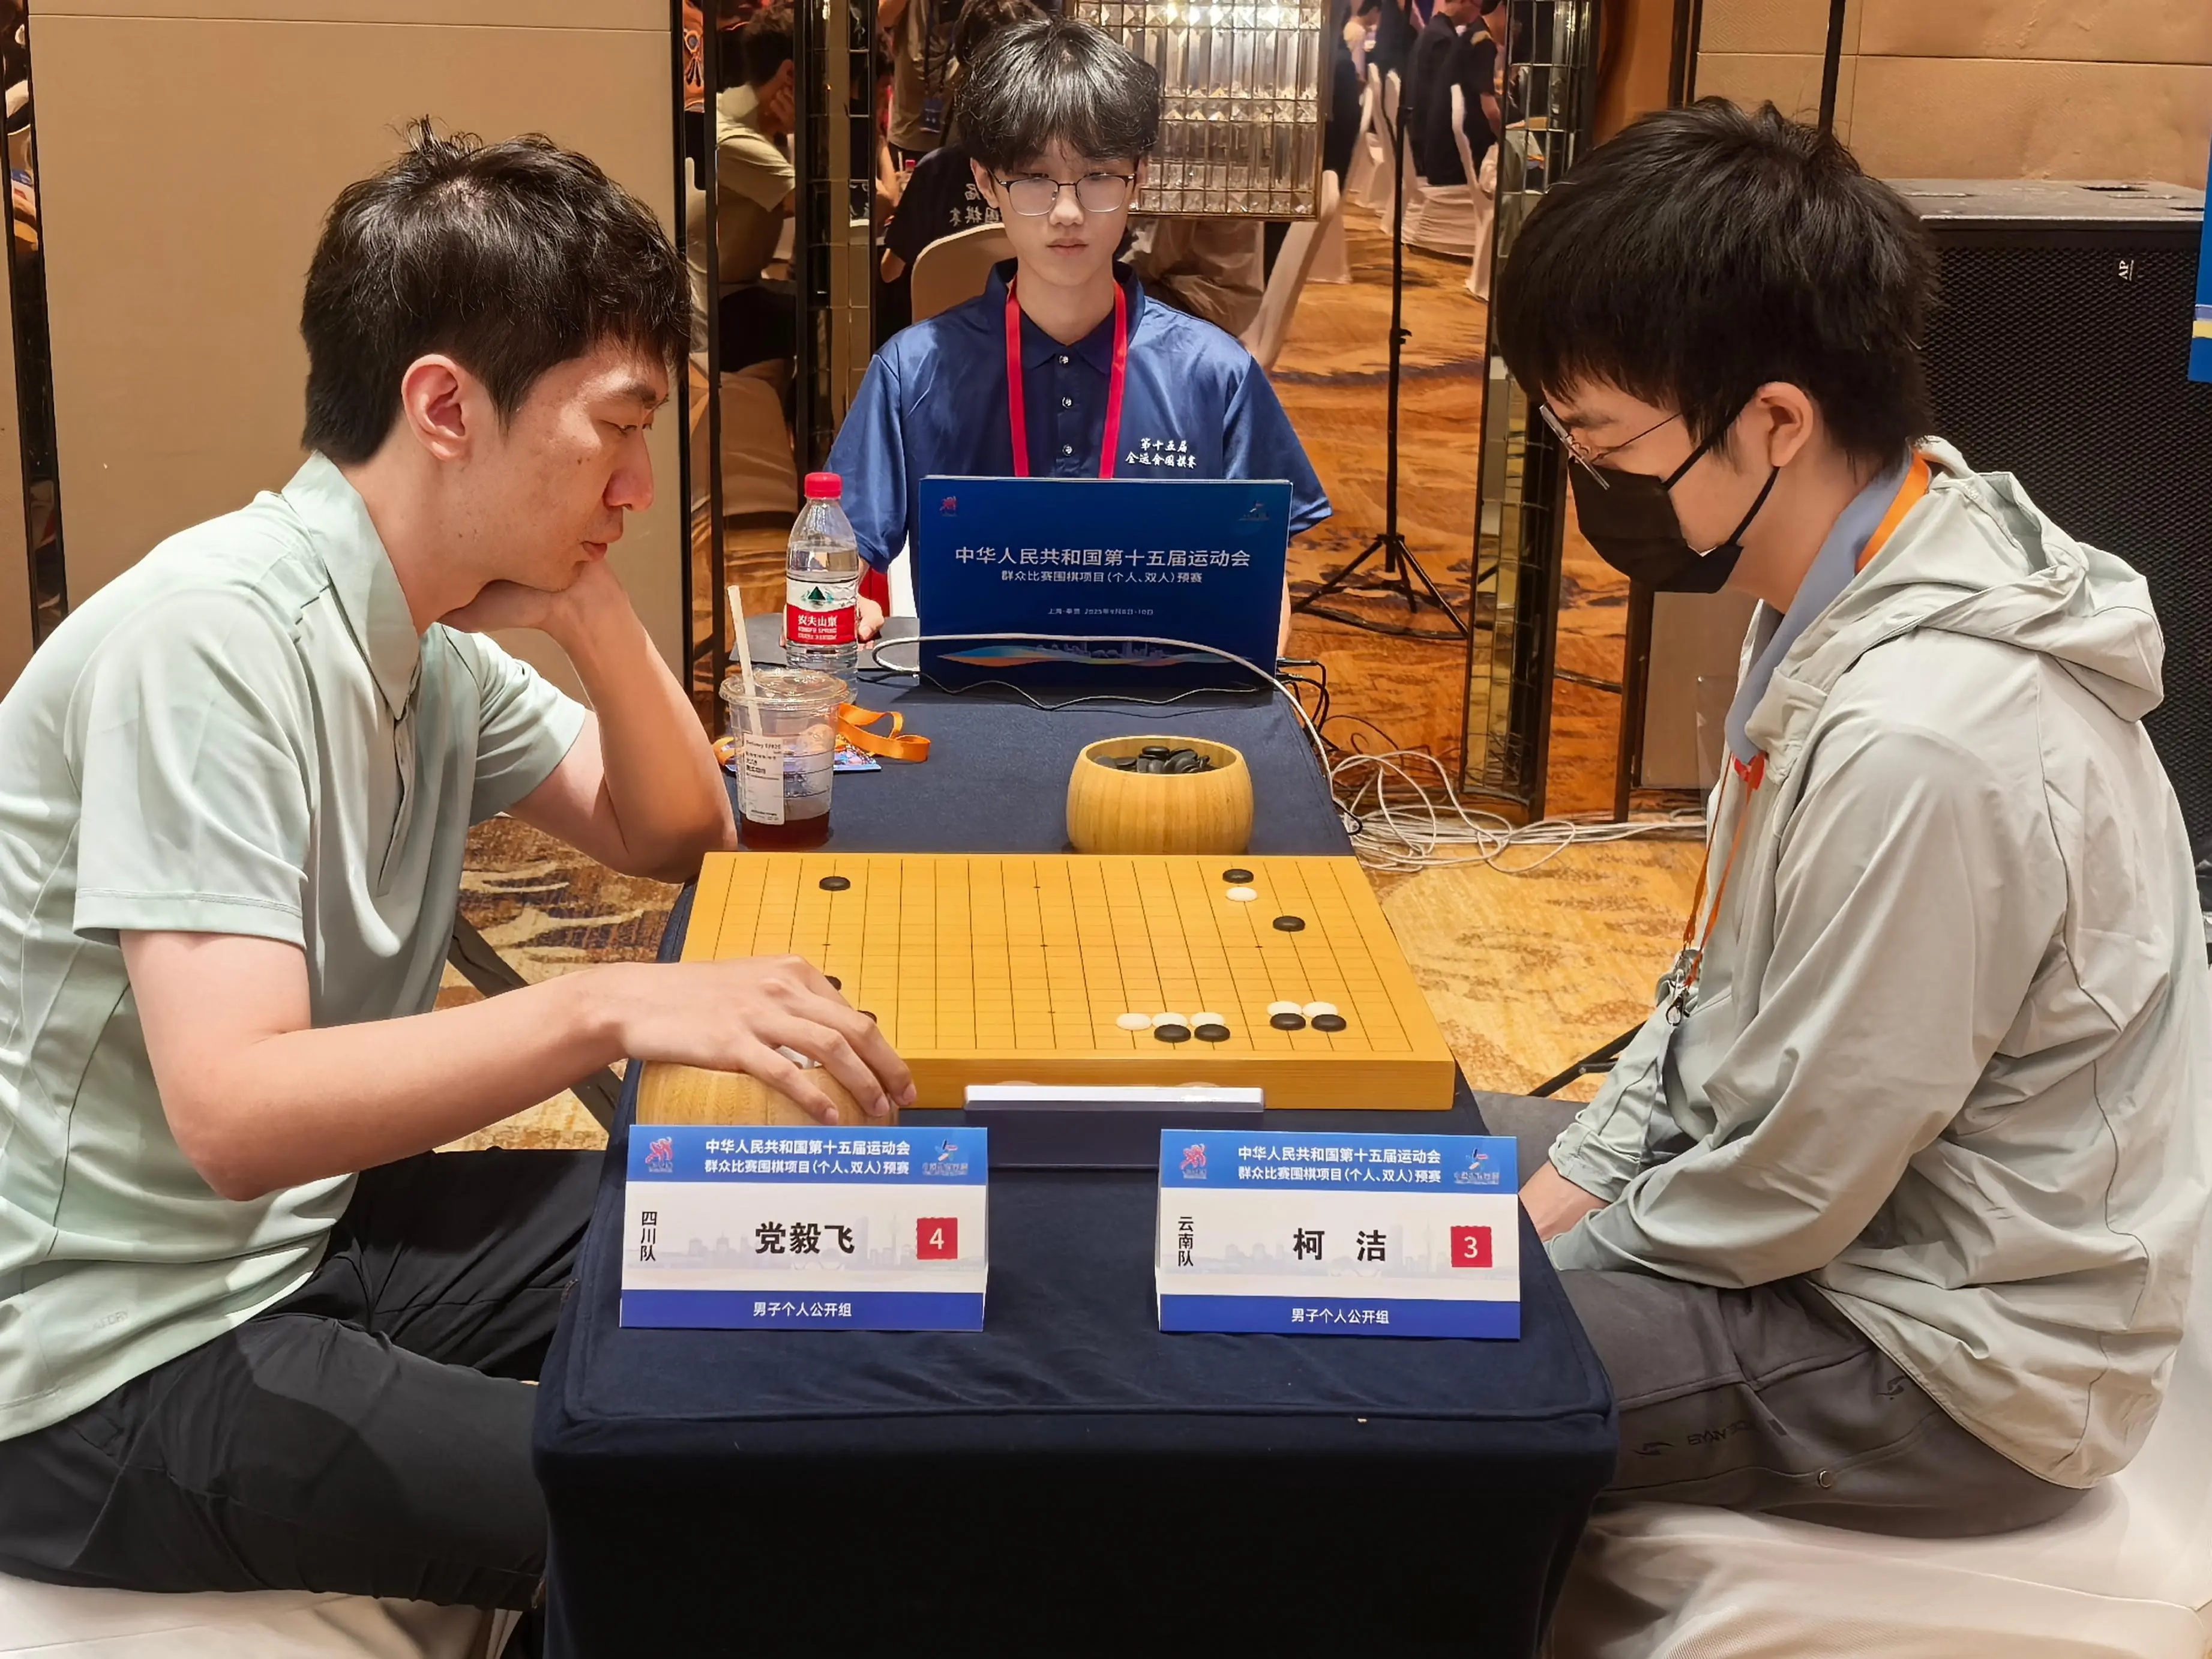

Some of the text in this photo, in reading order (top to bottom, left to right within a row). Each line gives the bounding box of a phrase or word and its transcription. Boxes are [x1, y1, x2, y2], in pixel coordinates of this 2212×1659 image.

[1140, 437, 1187, 453] 第十五届
[955, 546, 1251, 567] 中华人民共和国第十五届运动会
[798, 615, 838, 627] 农夫山泉
[705, 1138, 910, 1156] 中华人民共和国第十五届运动会
[1237, 1145, 1441, 1164] 中华人民共和国第十五届运动会
[640, 1211, 658, 1262] 四川队
[754, 1220, 856, 1255] 党毅飞
[929, 1227, 945, 1250] 4
[1177, 1215, 1194, 1267] 云南队
[1463, 1235, 1479, 1259] 3
[753, 1301, 853, 1317] 男子个人公开组
[1291, 1307, 1390, 1325] 男子个人公开组
